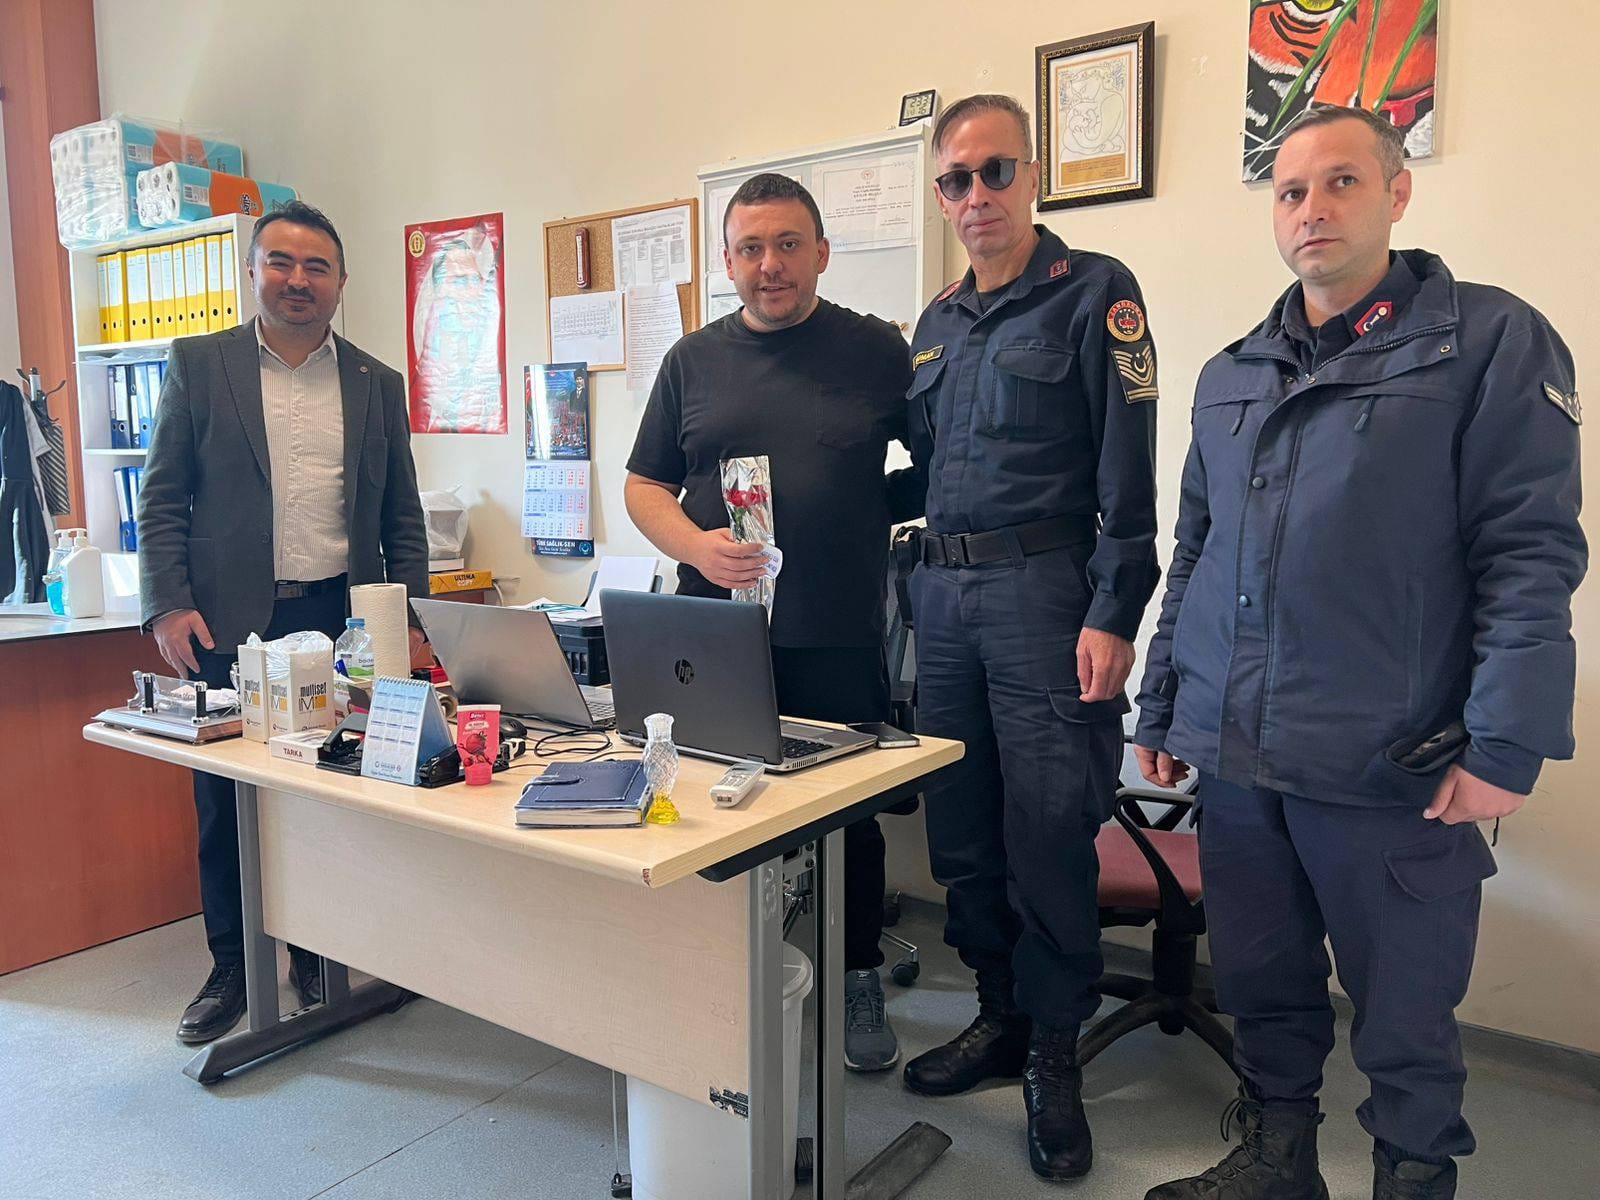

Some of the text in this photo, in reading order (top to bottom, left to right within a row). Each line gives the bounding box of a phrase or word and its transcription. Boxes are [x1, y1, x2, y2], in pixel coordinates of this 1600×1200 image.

[454, 573, 475, 581] ULTIMA
[300, 681, 327, 697] multiset
[283, 747, 303, 758] TARKA
